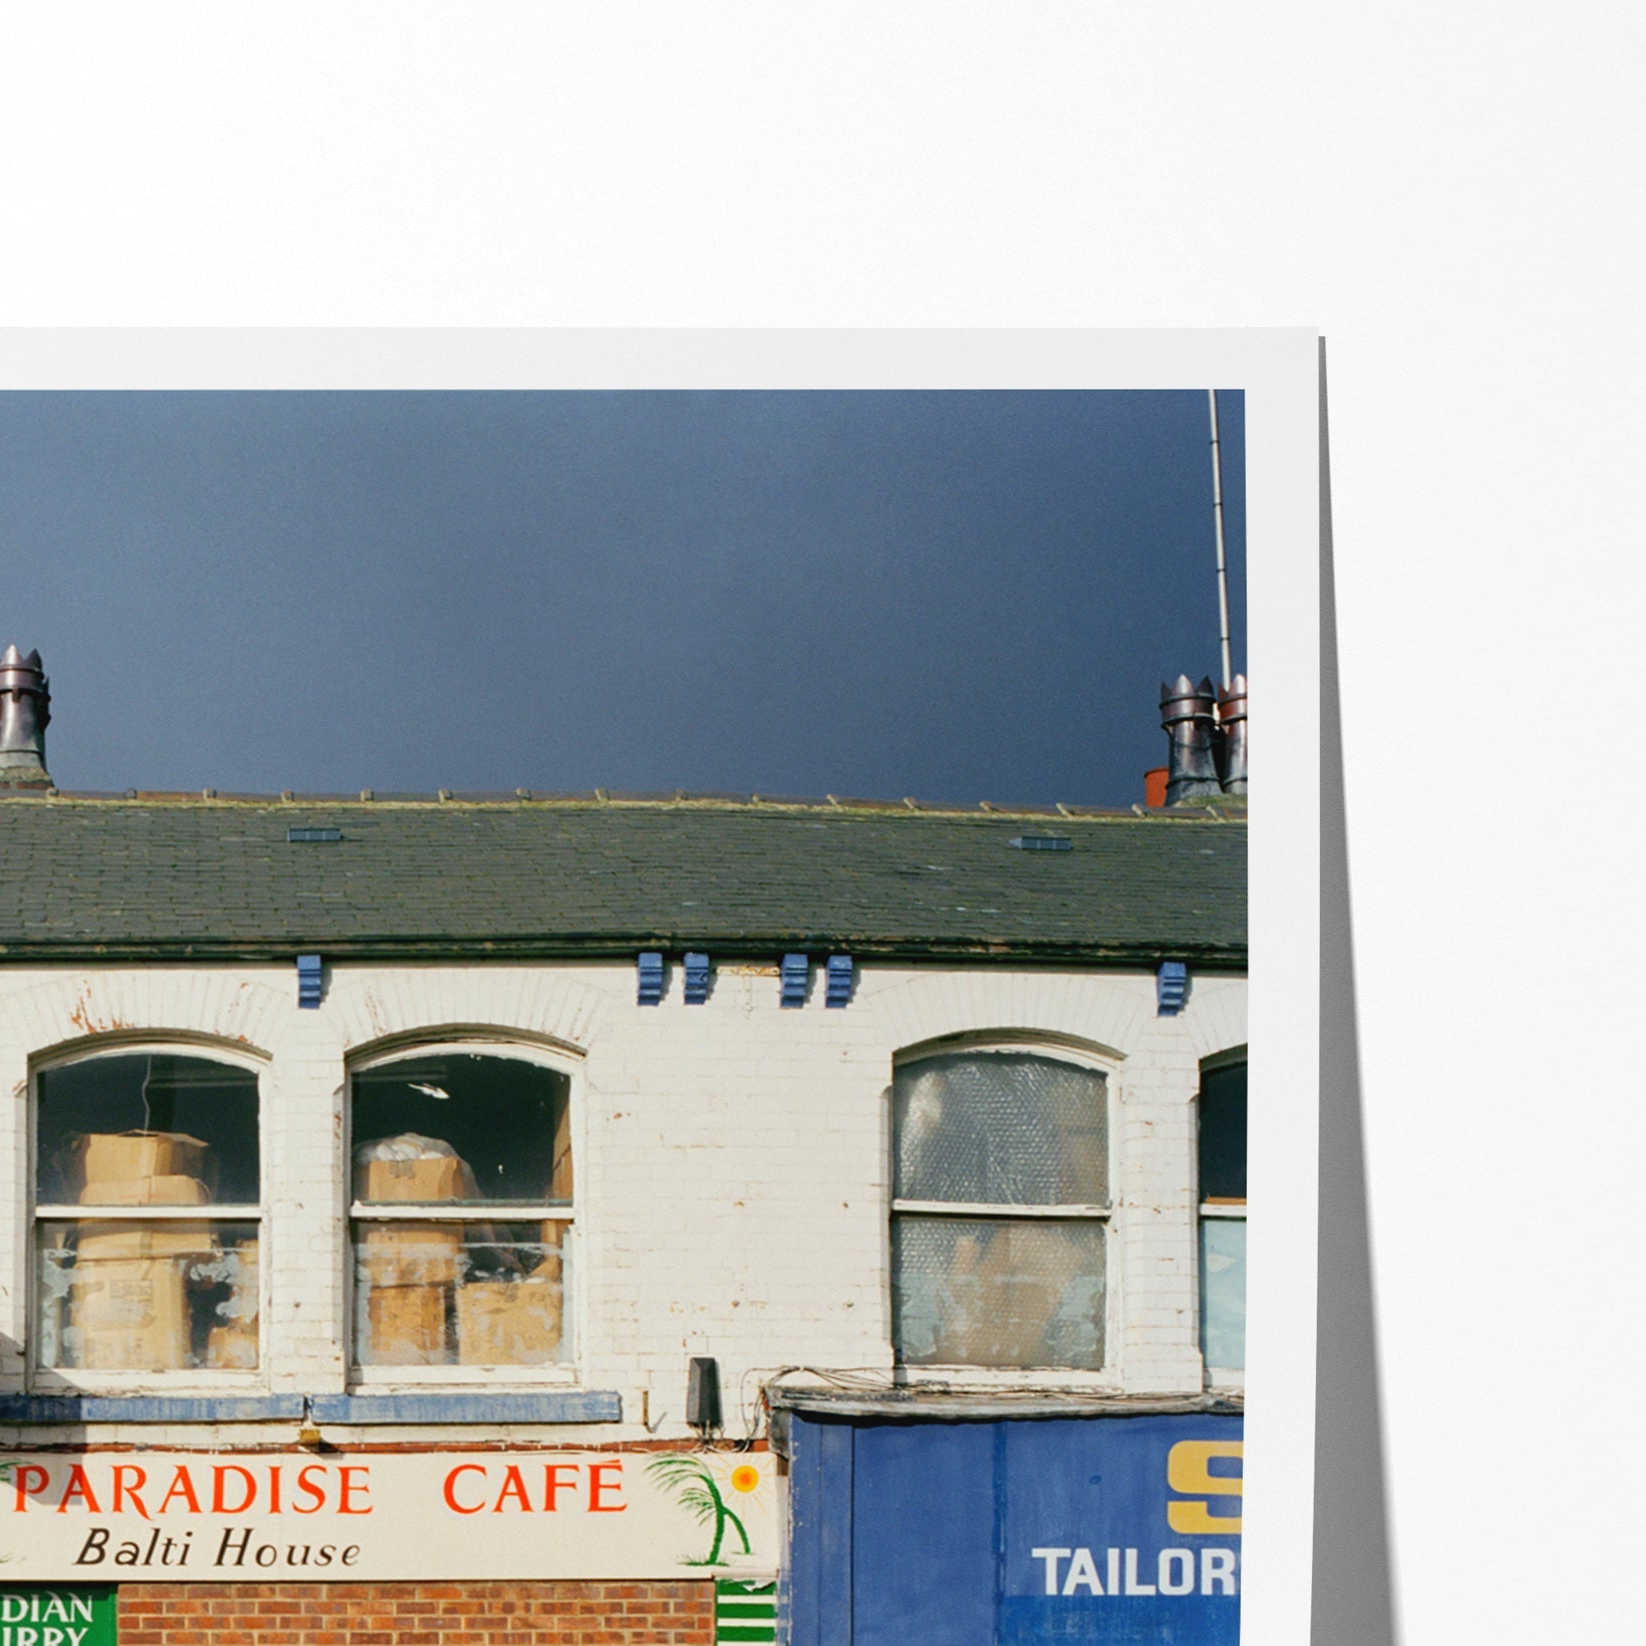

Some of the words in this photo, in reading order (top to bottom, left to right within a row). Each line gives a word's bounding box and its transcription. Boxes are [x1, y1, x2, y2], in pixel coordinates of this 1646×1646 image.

[13, 1464, 373, 1520] PARADISE
[443, 1459, 627, 1515] CAFÉ
[71, 1527, 193, 1566] Balti
[213, 1527, 361, 1567] House
[1032, 1548, 1235, 1596] TAILOR
